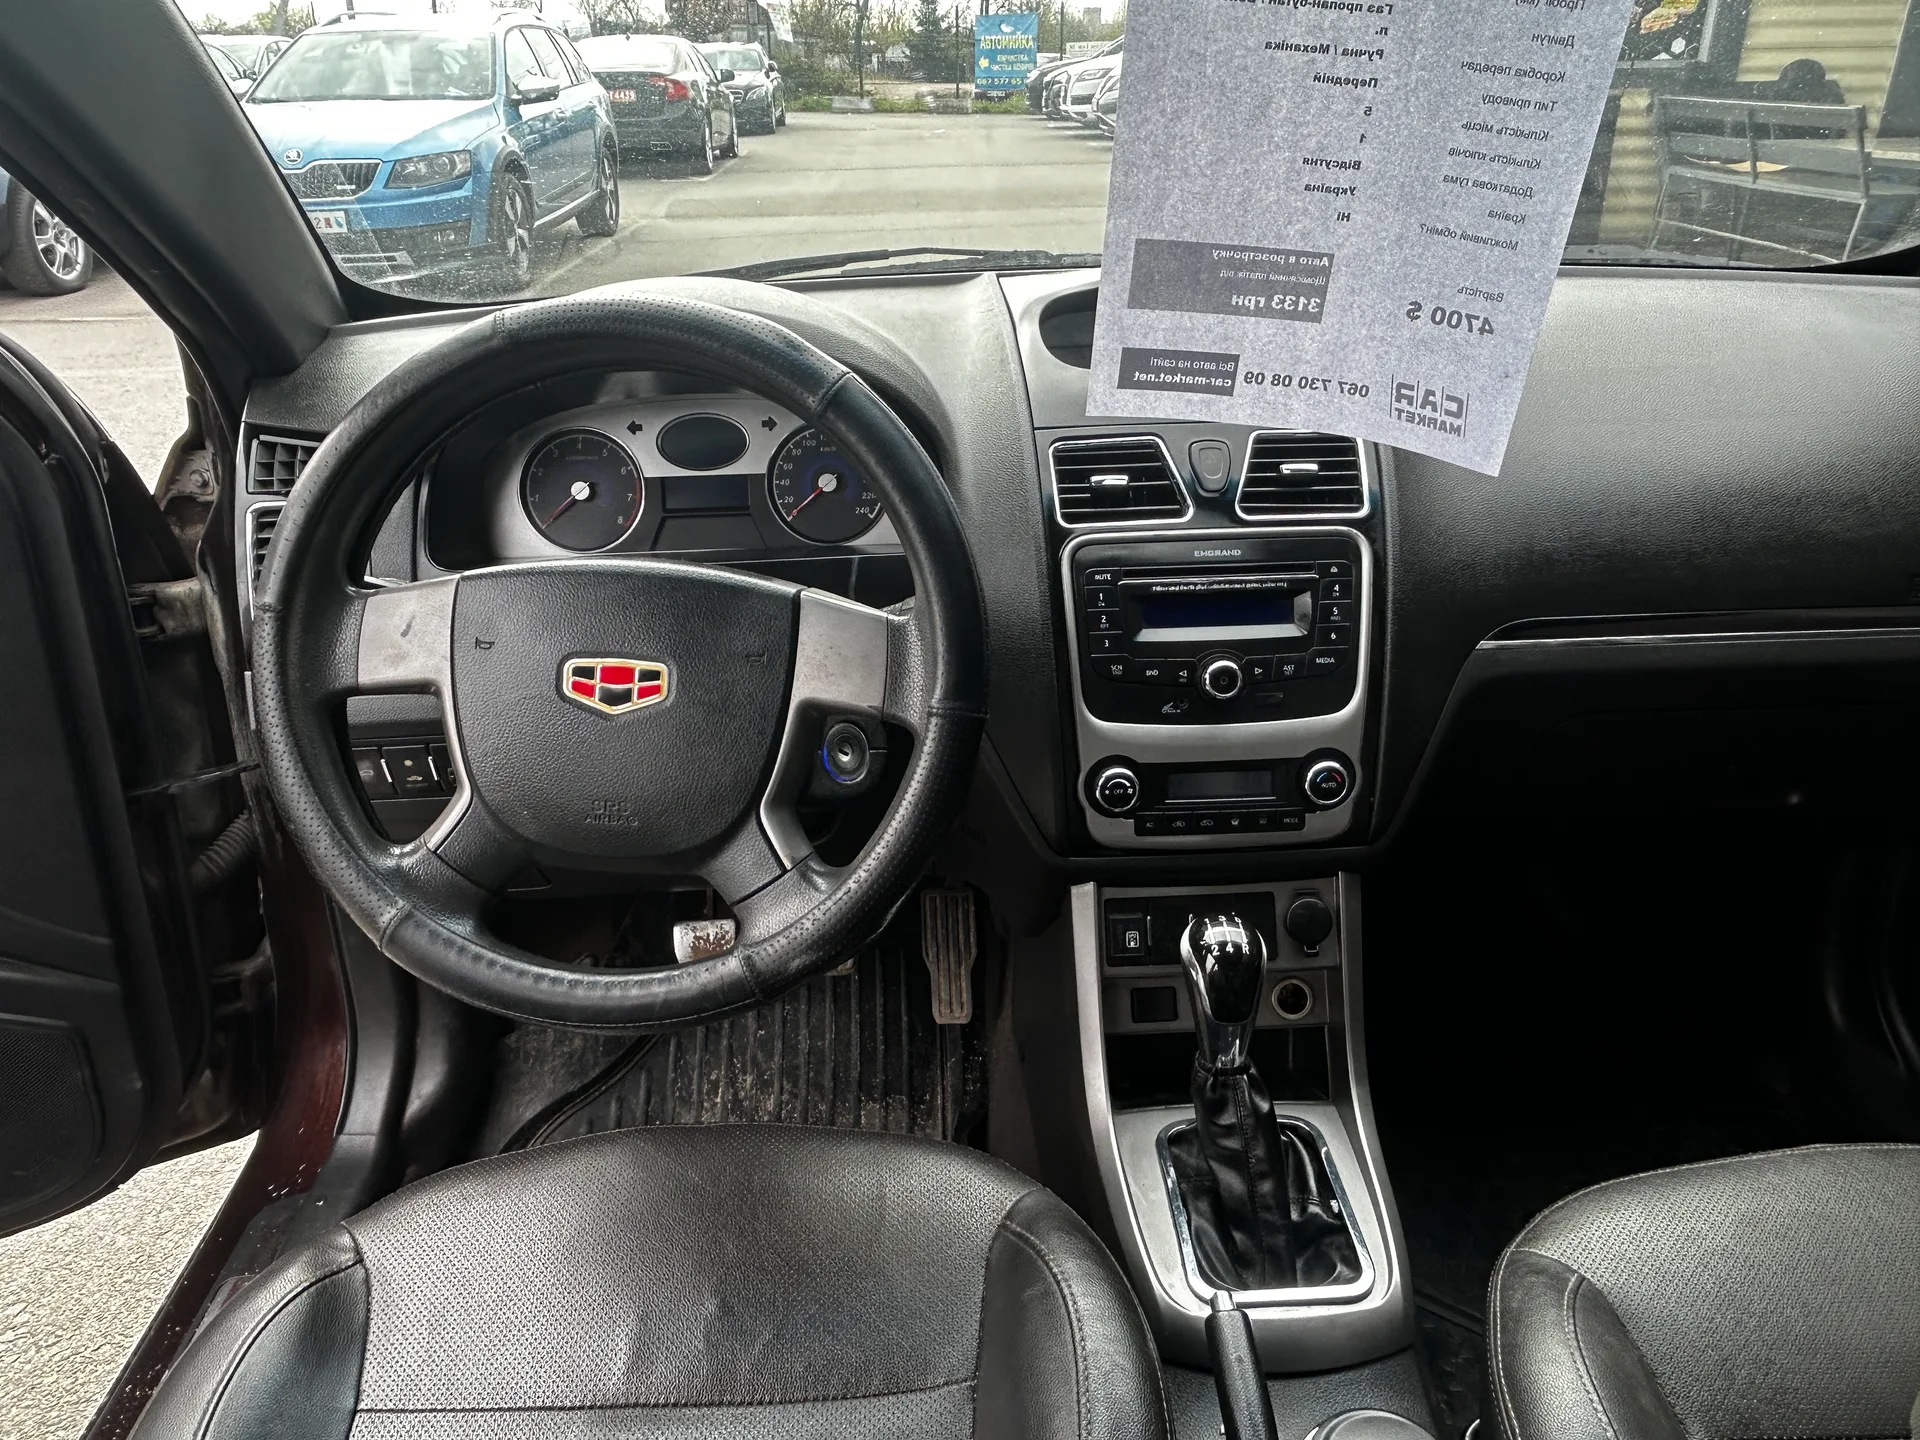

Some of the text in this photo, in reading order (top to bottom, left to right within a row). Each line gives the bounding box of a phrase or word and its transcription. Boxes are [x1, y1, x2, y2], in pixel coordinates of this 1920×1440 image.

[1194, 549, 1241, 557] EMGRAND
[1333, 607, 1338, 615] 5
[1211, 942, 1250, 956] 2 4 R
